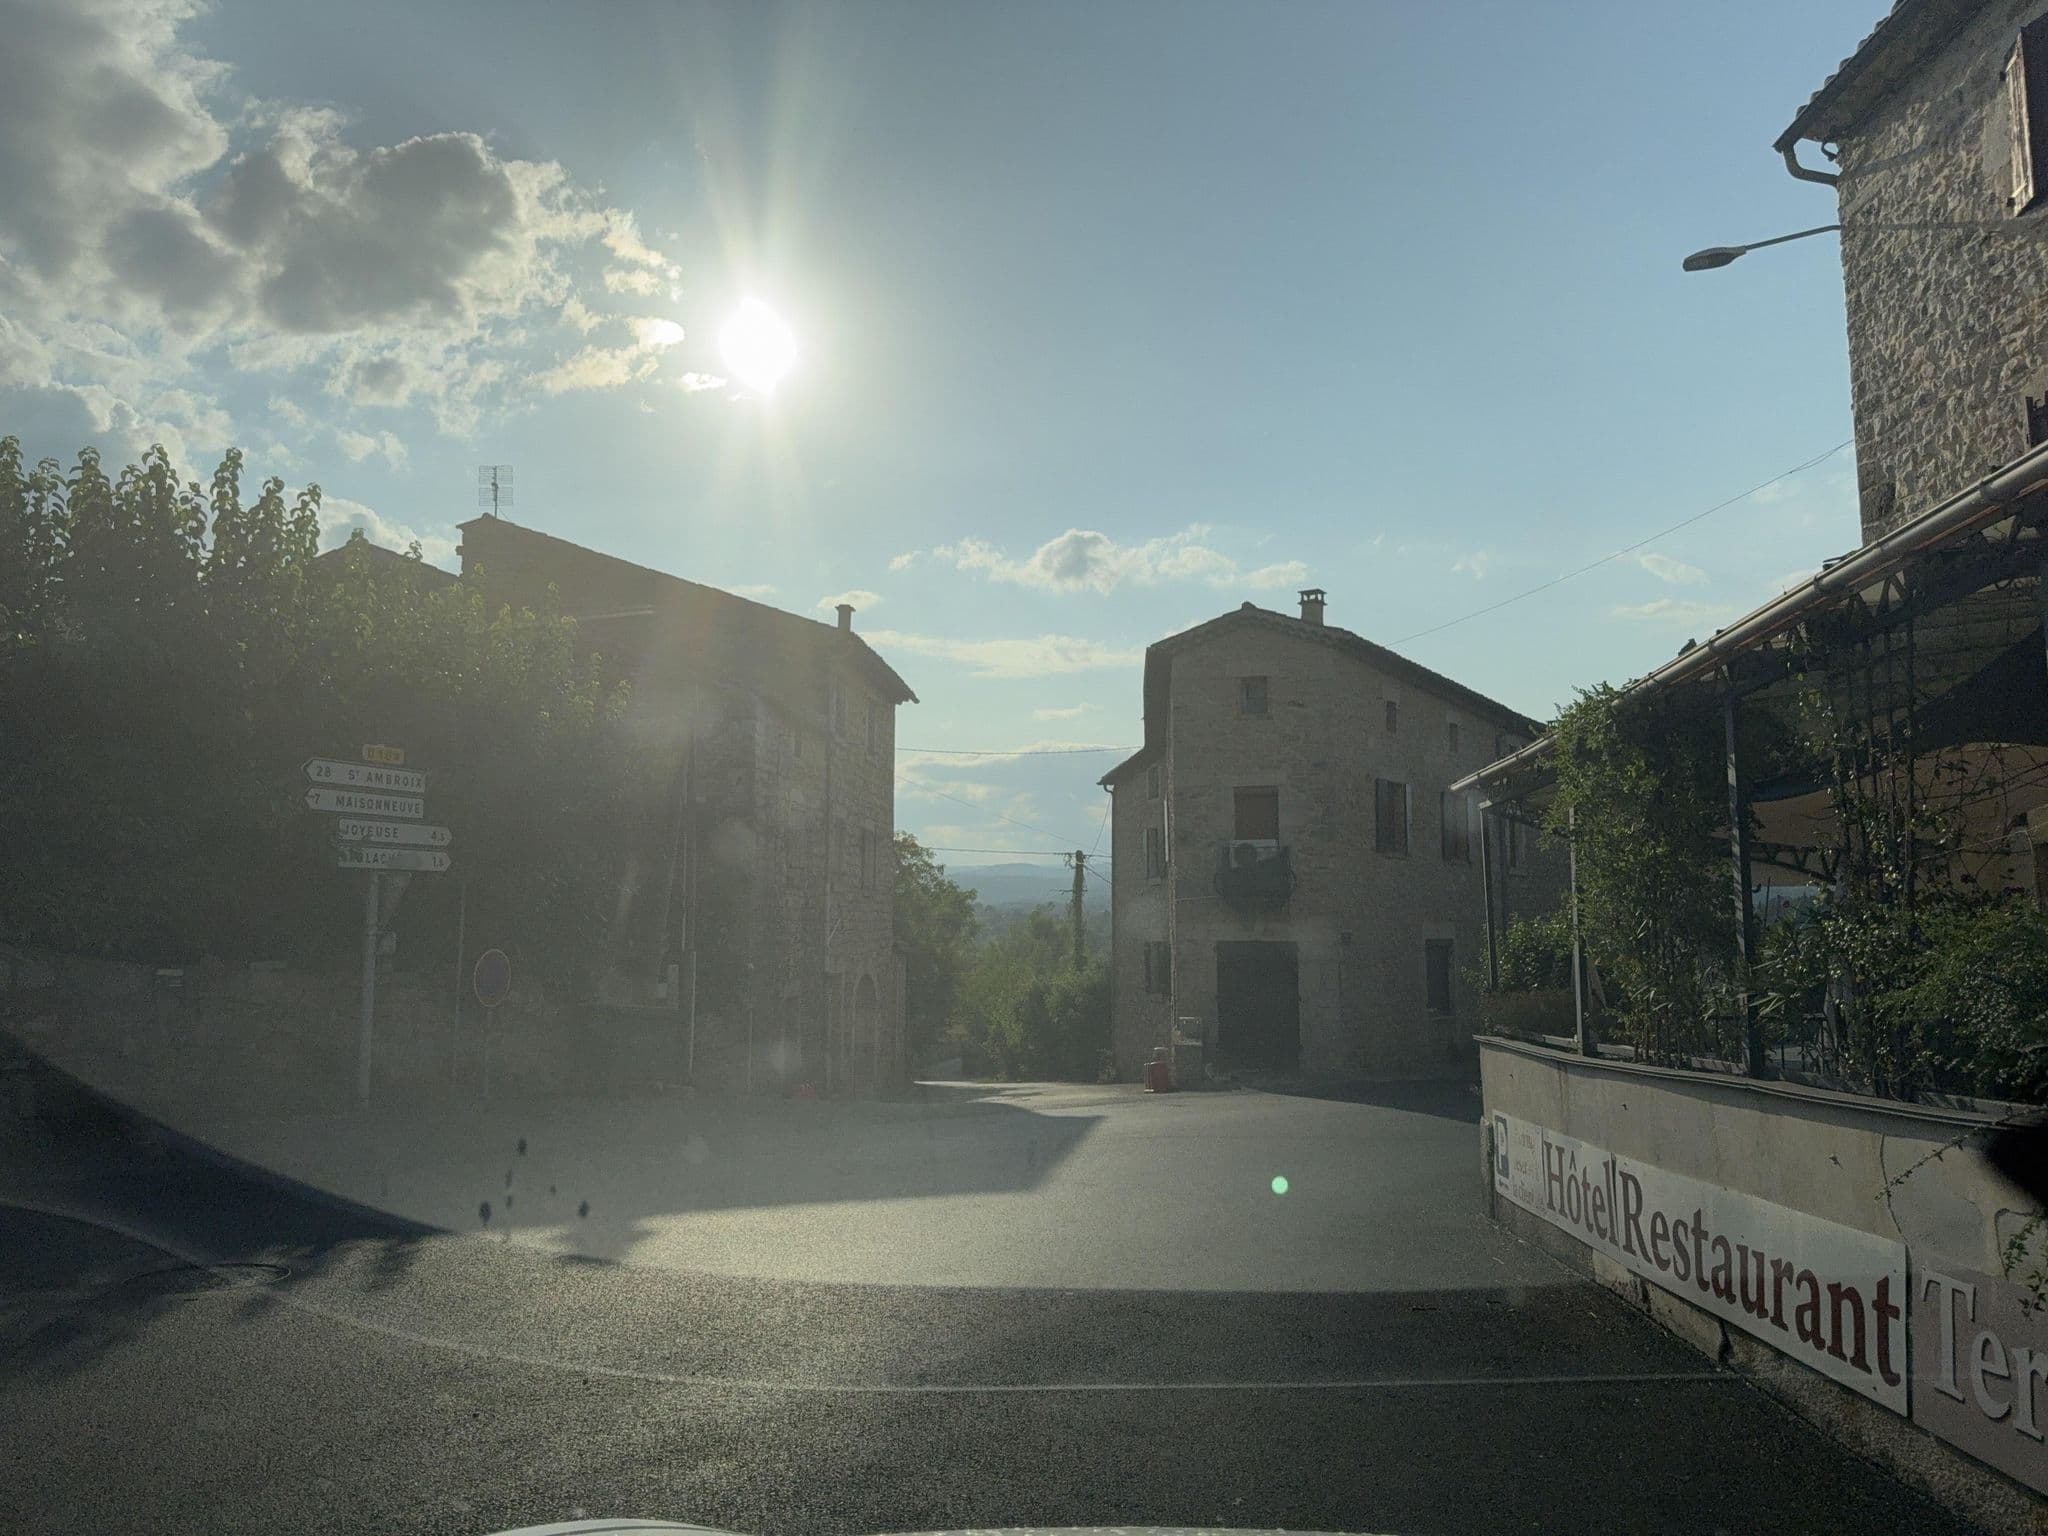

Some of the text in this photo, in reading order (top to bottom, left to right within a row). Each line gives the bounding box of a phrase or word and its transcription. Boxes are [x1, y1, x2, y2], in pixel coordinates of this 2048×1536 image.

[316, 765, 331, 778] 28
[366, 771, 422, 789] AMBROIX
[314, 793, 420, 815] 7 MAISONNEUVE
[344, 824, 399, 839] JOYEUSE
[1543, 1140, 1901, 1388] Hôtel Restaurant
[1920, 1265, 2048, 1444] Ter
